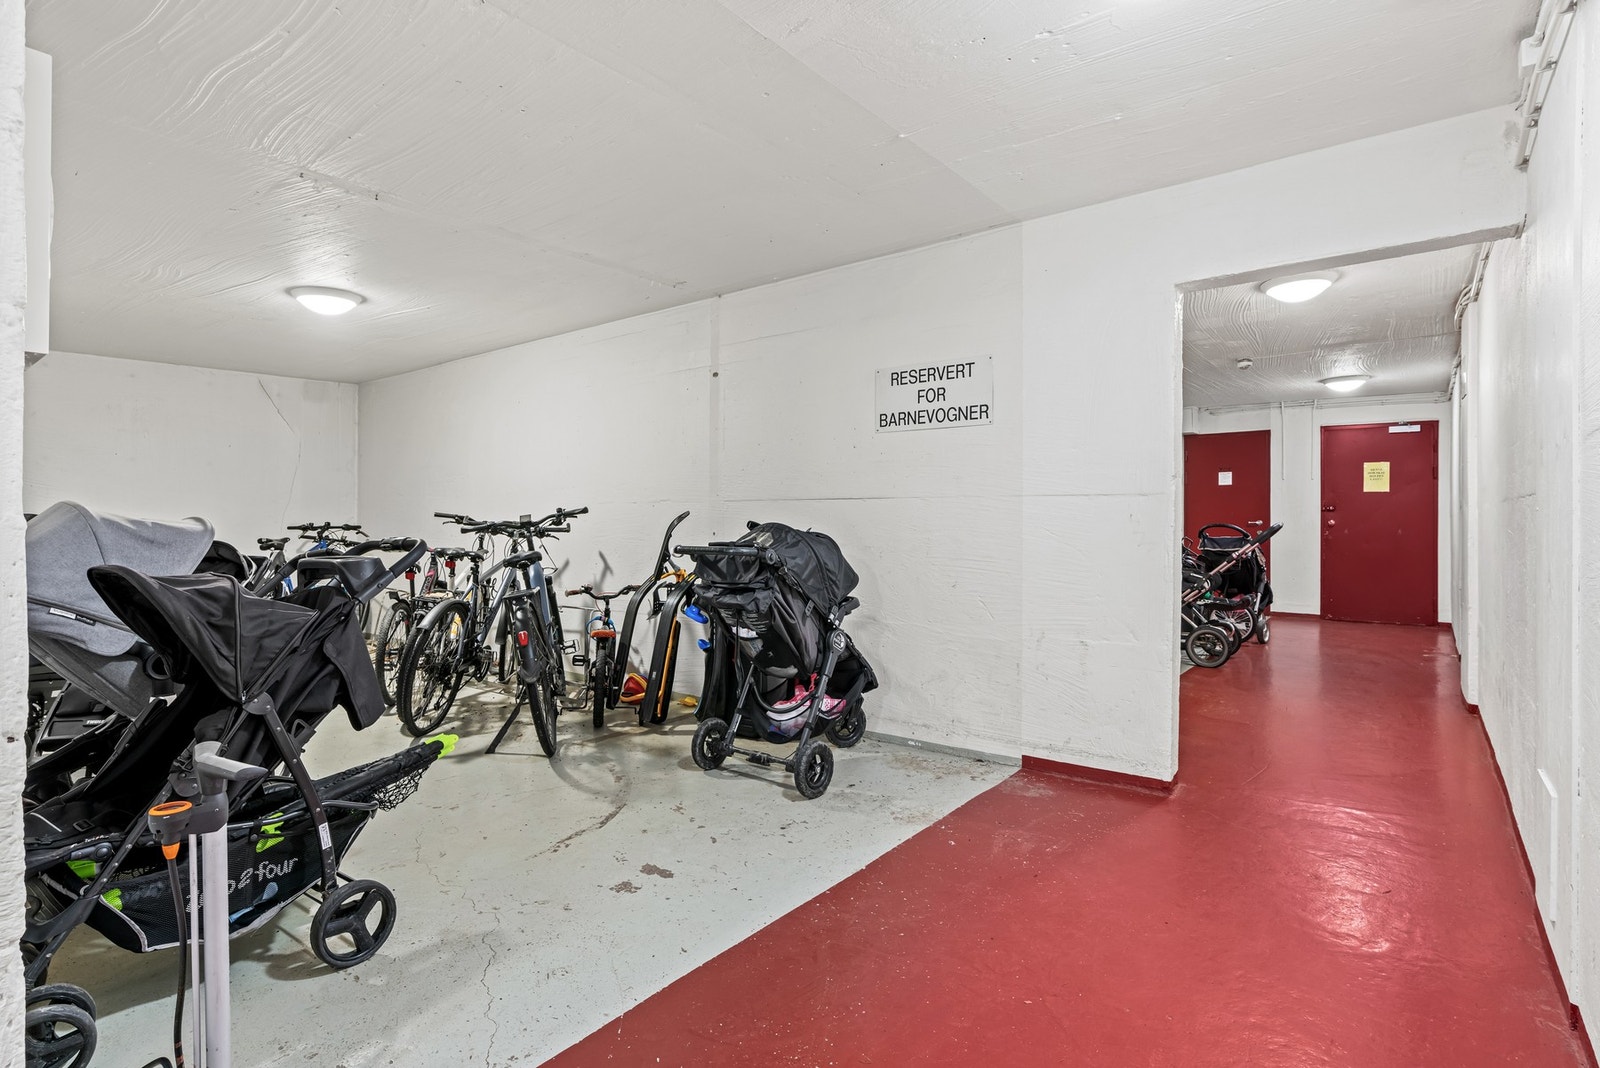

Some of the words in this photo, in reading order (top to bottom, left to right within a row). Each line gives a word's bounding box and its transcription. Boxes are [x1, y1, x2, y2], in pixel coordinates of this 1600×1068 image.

[890, 362, 975, 386] RESERVERT
[917, 387, 946, 404] FOR
[879, 404, 989, 428] BARNEVOGNER
